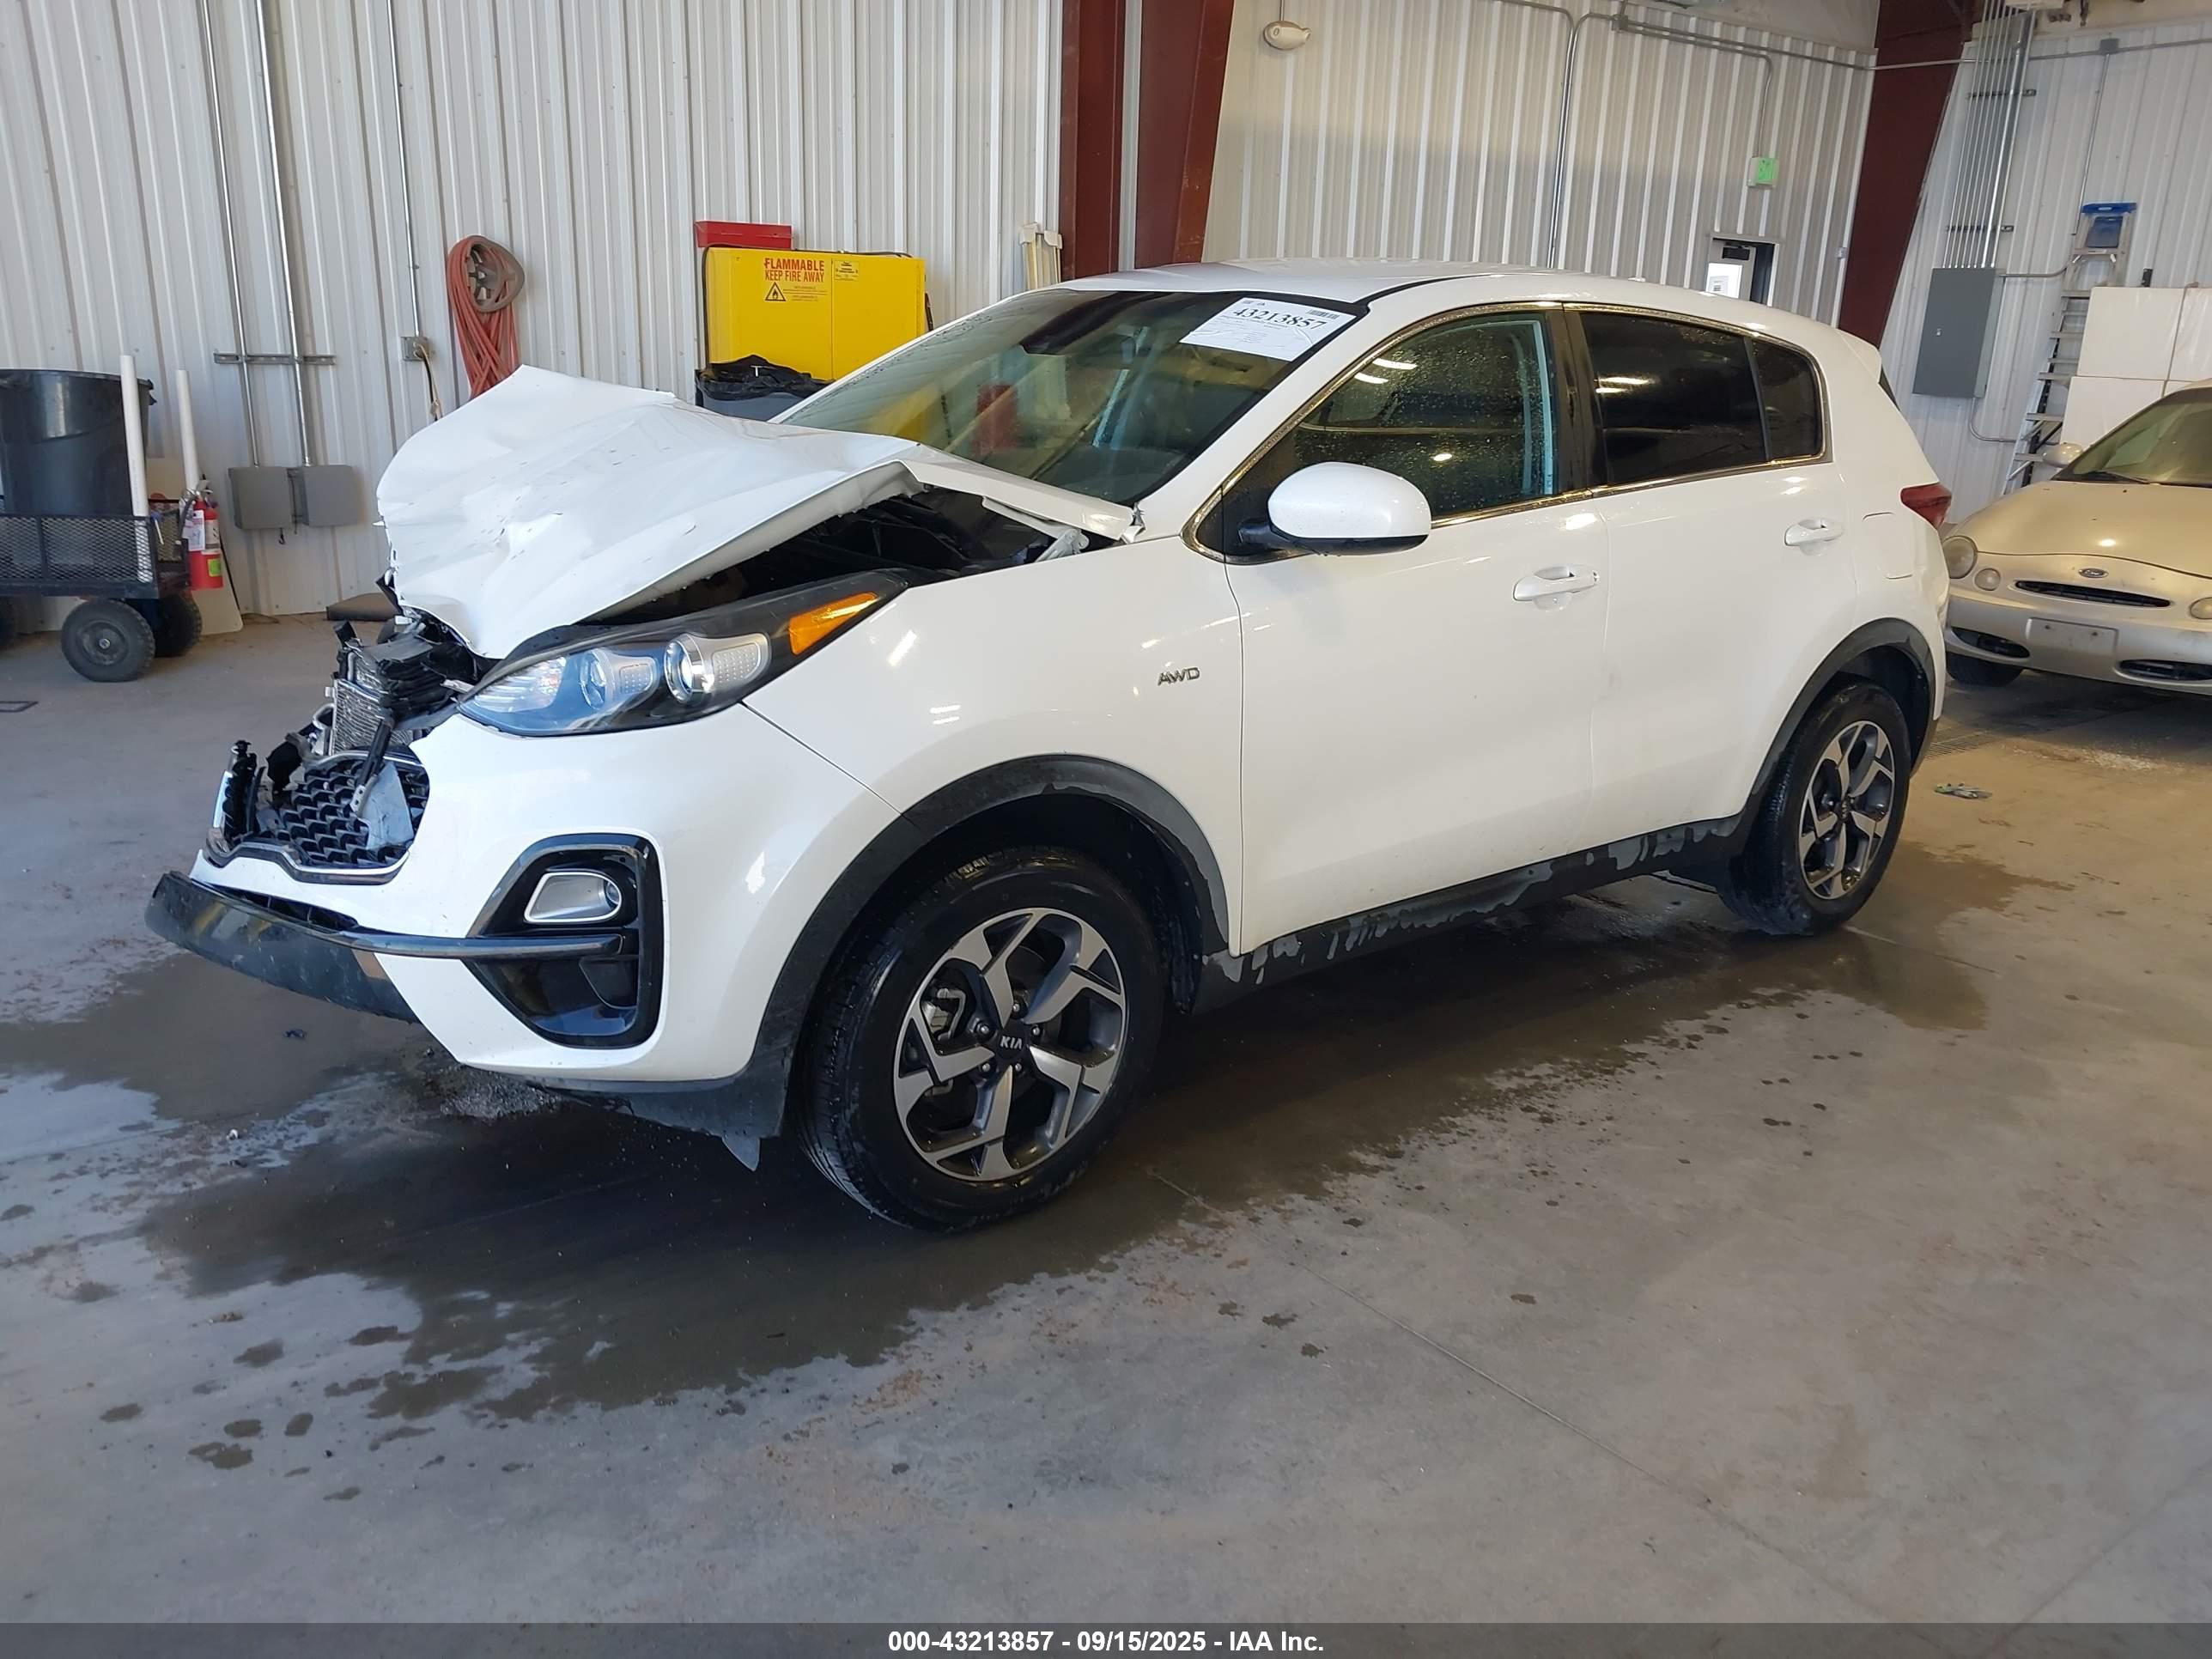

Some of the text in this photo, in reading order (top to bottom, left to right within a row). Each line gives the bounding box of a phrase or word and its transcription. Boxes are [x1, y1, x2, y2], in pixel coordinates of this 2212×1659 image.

[764, 258, 824, 271] FLAMMABLE
[765, 270, 824, 283] KEEP FIRE AWAY
[1233, 307, 1328, 330] 43213857
[1158, 667, 1200, 686] AWD
[1000, 1036, 1023, 1049] KIA
